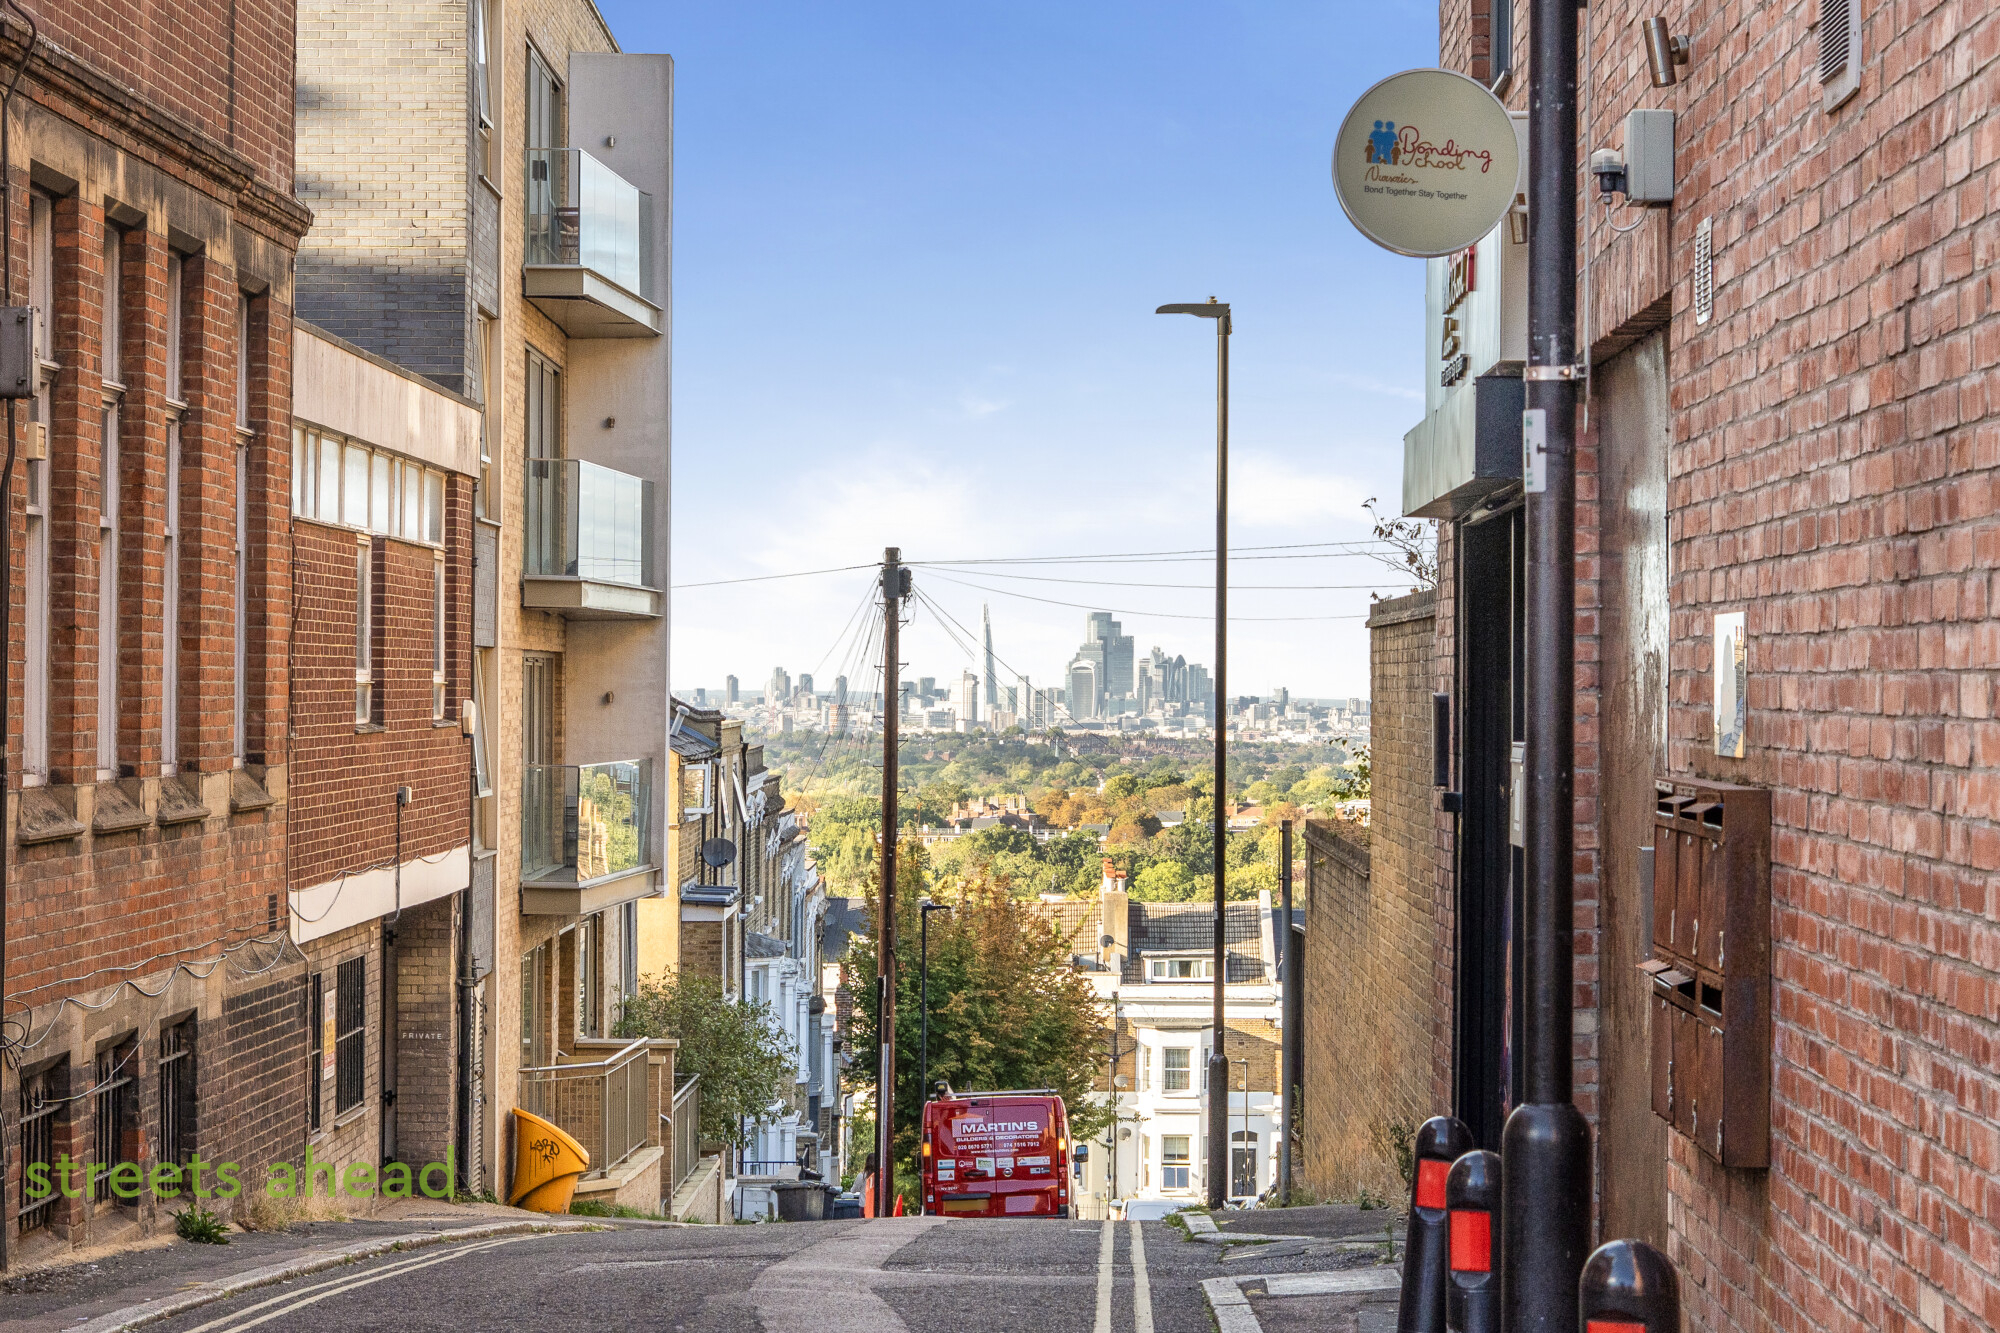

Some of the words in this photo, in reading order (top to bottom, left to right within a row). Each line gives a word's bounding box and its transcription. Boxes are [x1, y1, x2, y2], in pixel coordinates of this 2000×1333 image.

[1398, 125, 1493, 173] Bonding
[1401, 141, 1466, 170] School
[1364, 165, 1418, 184] Nurseries
[1364, 185, 1384, 194] Bond
[1386, 187, 1417, 197] Together
[1418, 188, 1435, 199] Stay
[1437, 190, 1468, 201] Together
[402, 1032, 442, 1040] PRIVATE
[962, 1121, 1038, 1134] MARTIN'S
